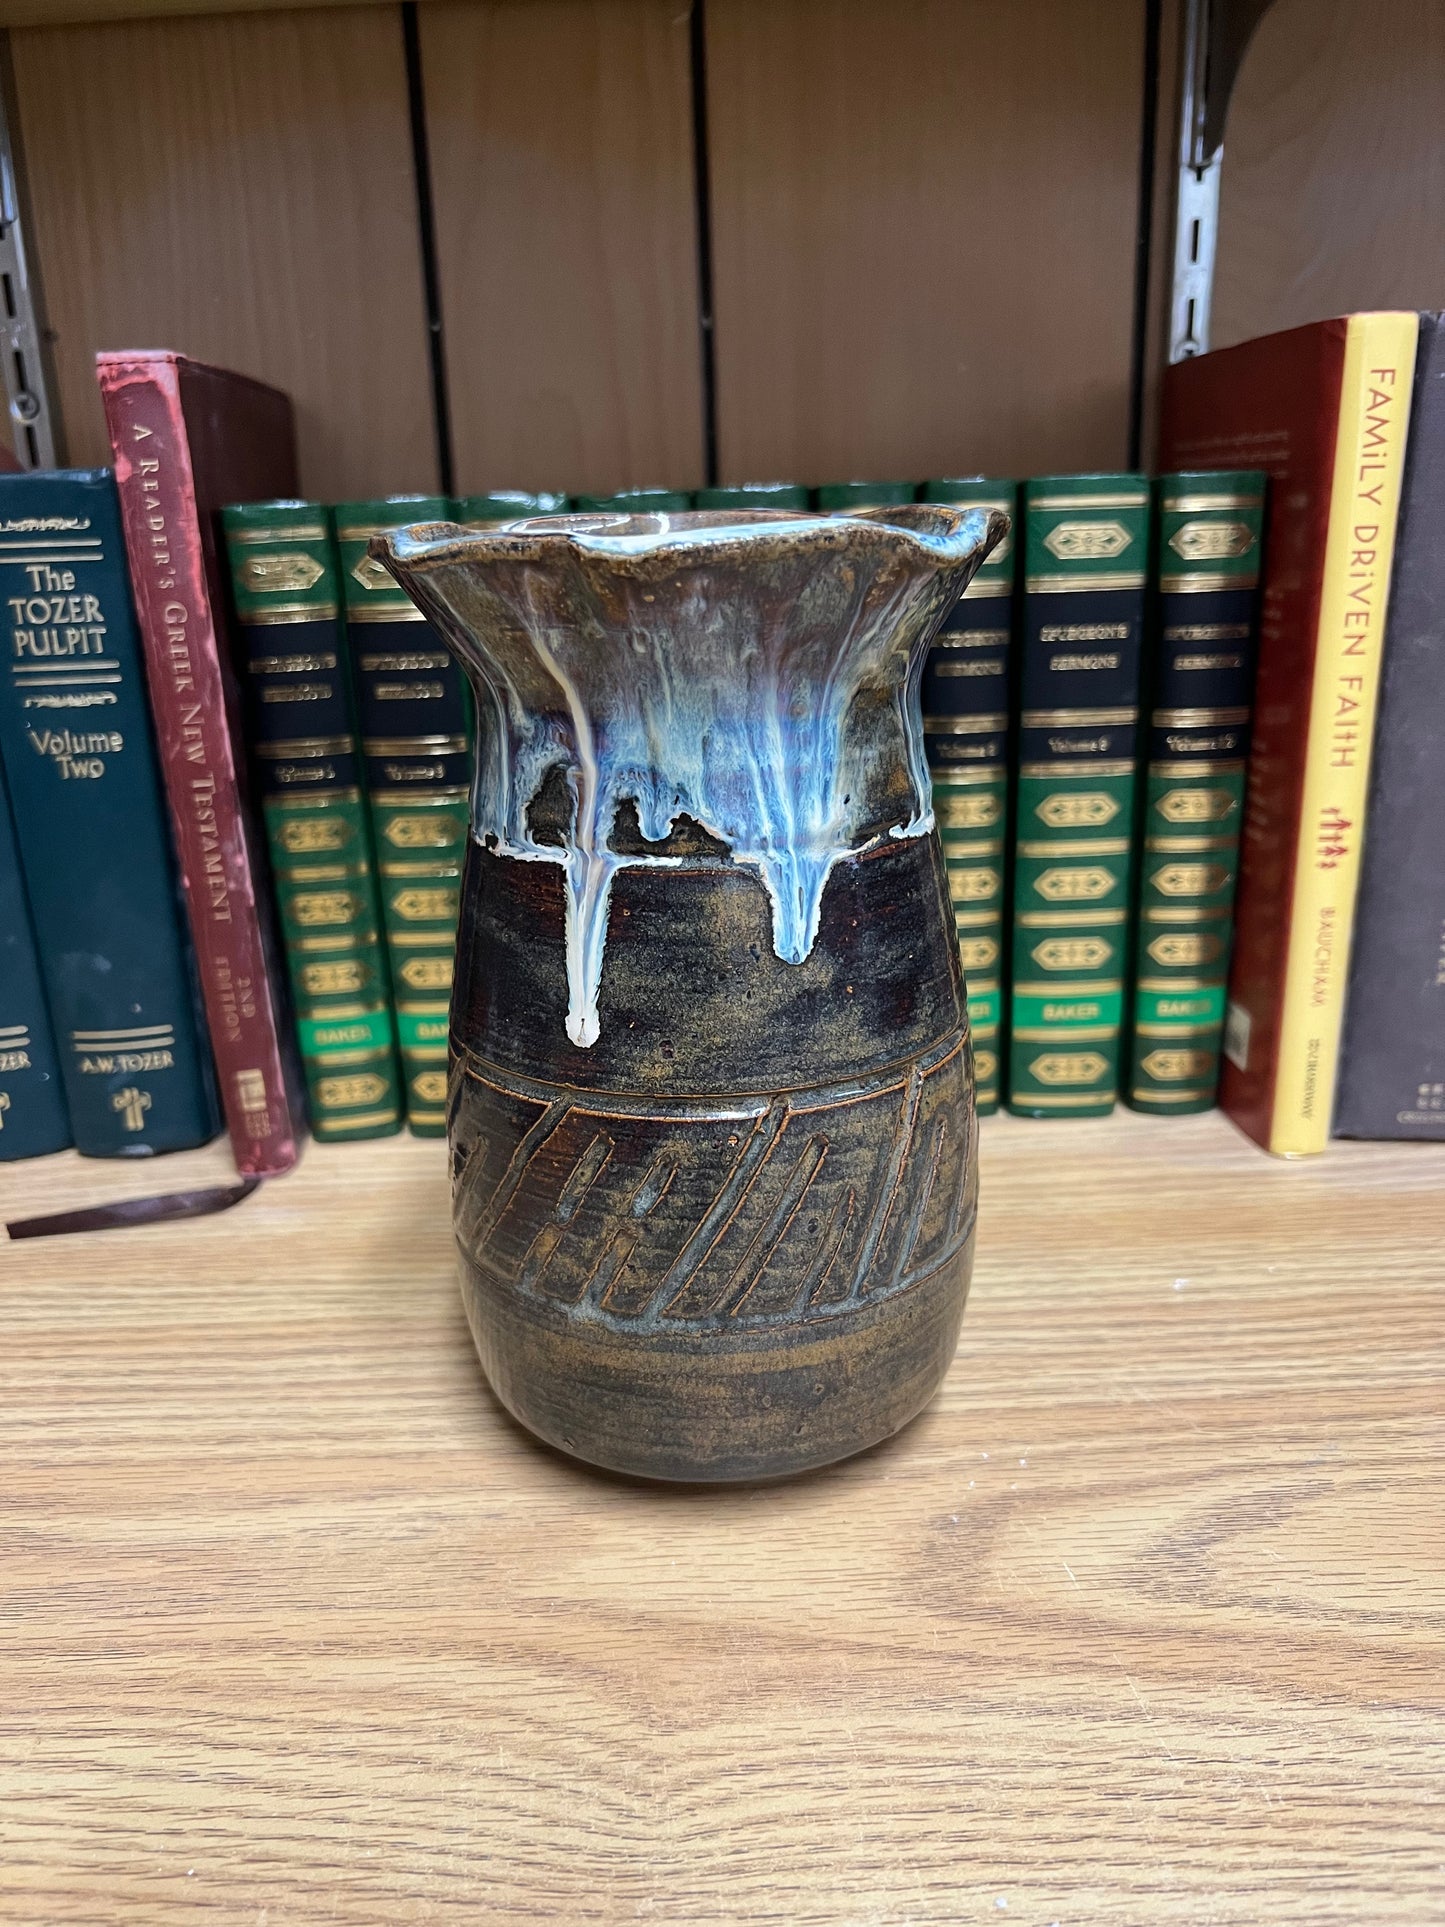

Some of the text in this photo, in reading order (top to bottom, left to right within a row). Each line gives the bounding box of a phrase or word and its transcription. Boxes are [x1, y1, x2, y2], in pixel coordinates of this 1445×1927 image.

[25, 564, 76, 593] The
[8, 593, 105, 626] TOZER
[14, 625, 107, 657] PULPIT
[132, 423, 233, 925] A READER'S GREEK NEW TESTAMENT
[29, 728, 124, 756] Volume
[56, 754, 105, 780] Two
[1042, 1003, 1099, 1021] BAKER
[314, 1024, 373, 1046] BAKER
